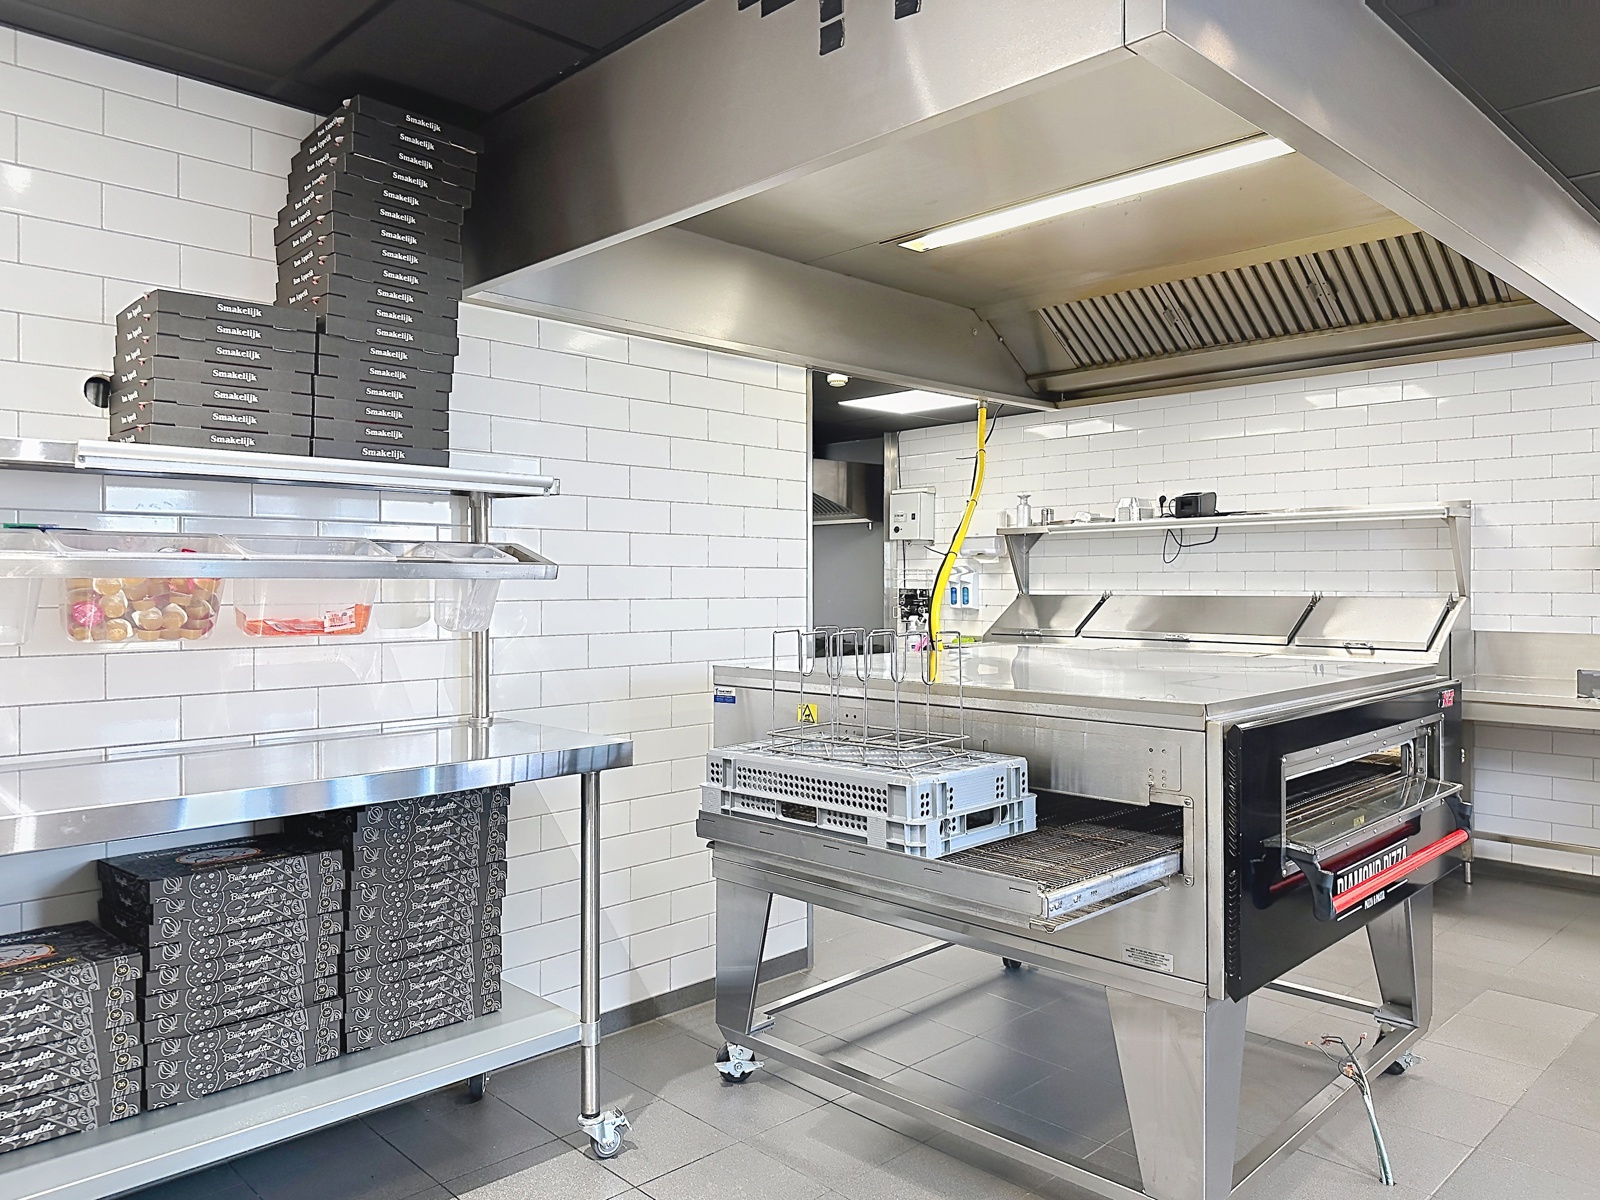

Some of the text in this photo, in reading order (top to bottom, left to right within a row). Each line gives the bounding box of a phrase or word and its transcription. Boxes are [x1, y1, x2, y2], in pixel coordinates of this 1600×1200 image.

[405, 114, 442, 132] Smakelijk
[399, 133, 435, 150] Smakelijk
[398, 152, 433, 170] Smakelijk
[392, 171, 428, 188] Smakelijk
[383, 189, 420, 206] Smakelijk
[380, 209, 416, 224] Smakelijk
[380, 229, 418, 245] Smakelijk
[382, 249, 419, 264] Smakelijk
[383, 270, 419, 285] Smakelijk
[377, 288, 414, 303] Smakelijk
[216, 303, 262, 318] Smakelijk
[376, 309, 413, 323] Smakelijk
[216, 325, 262, 339] Smakelijk
[376, 328, 414, 341] Smakelijk
[216, 346, 261, 360] Smakelijk
[370, 347, 408, 360] Smakelijk
[212, 369, 257, 382] Smakelijk
[369, 367, 407, 380] Smakelijk
[214, 390, 258, 403] Smakelijk
[366, 388, 404, 400] Smakelijk
[212, 412, 257, 425] Smakelijk
[365, 408, 403, 419] Smakelijk
[210, 435, 255, 447] Smakelijk
[365, 428, 403, 439] Smakelijk
[362, 448, 405, 459] Smakelijk
[228, 868, 275, 882] Buon appetito
[251, 886, 278, 899] appetito
[226, 909, 274, 924] Buon appetito
[248, 931, 275, 945] appetito
[224, 954, 272, 970] Buon appetito
[24, 980, 58, 995] appetito
[224, 975, 271, 993] Buon appetito
[16, 1003, 51, 1019] appetito
[223, 1000, 271, 1017] Buon appetito
[17, 1025, 52, 1042] appetito
[248, 1022, 275, 1036] appetito
[244, 1043, 271, 1058] appetito
[21, 1050, 55, 1067] appetito
[225, 1061, 273, 1080] Buon appetito
[24, 1072, 59, 1090] appetito
[22, 1098, 57, 1116] appetito
[21, 1122, 56, 1140] appetito
